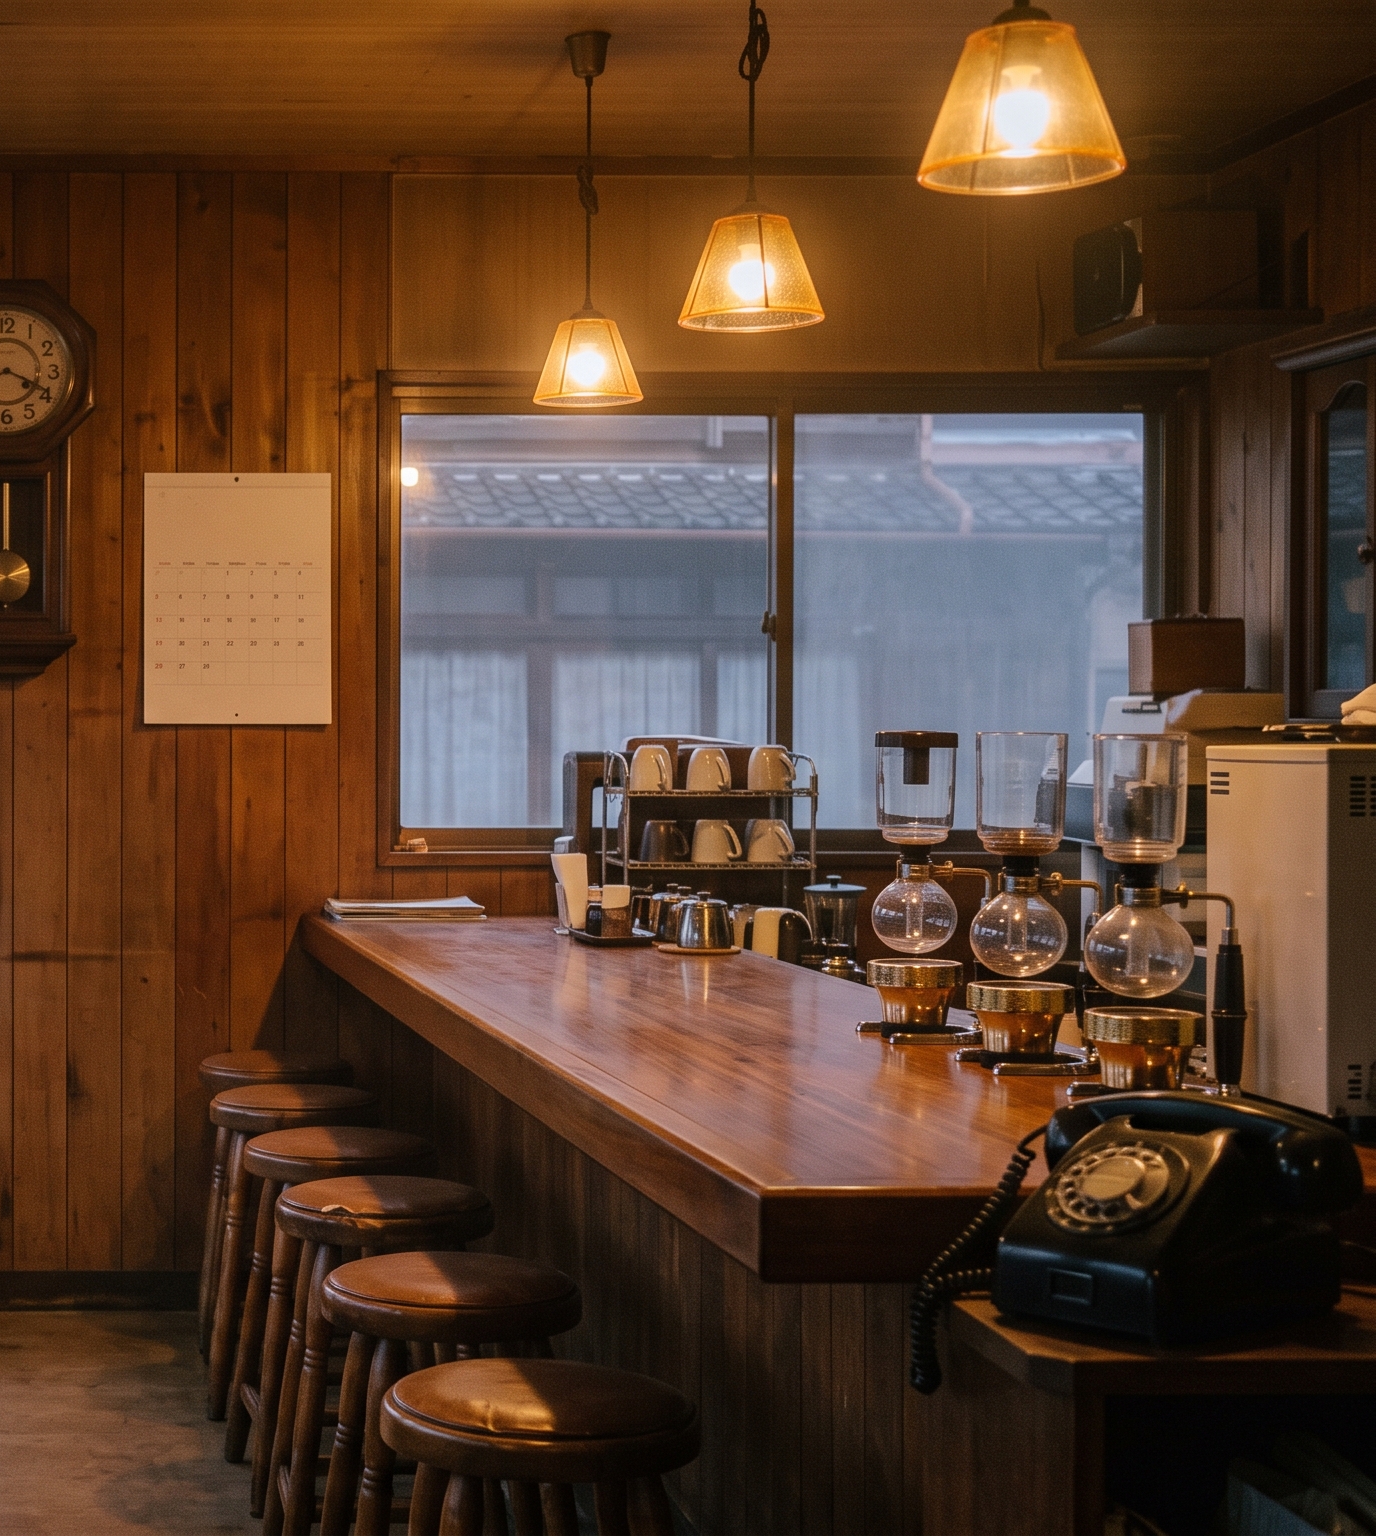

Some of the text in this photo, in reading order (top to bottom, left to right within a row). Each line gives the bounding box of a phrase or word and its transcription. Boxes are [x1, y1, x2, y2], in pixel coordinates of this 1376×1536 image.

[0, 317, 15, 333] 12
[28, 324, 32, 339] 1
[42, 340, 53, 356] 2
[47, 364, 60, 379] 3
[39, 387, 52, 403] 4
[1, 409, 13, 424] 6
[24, 404, 35, 419] 5
